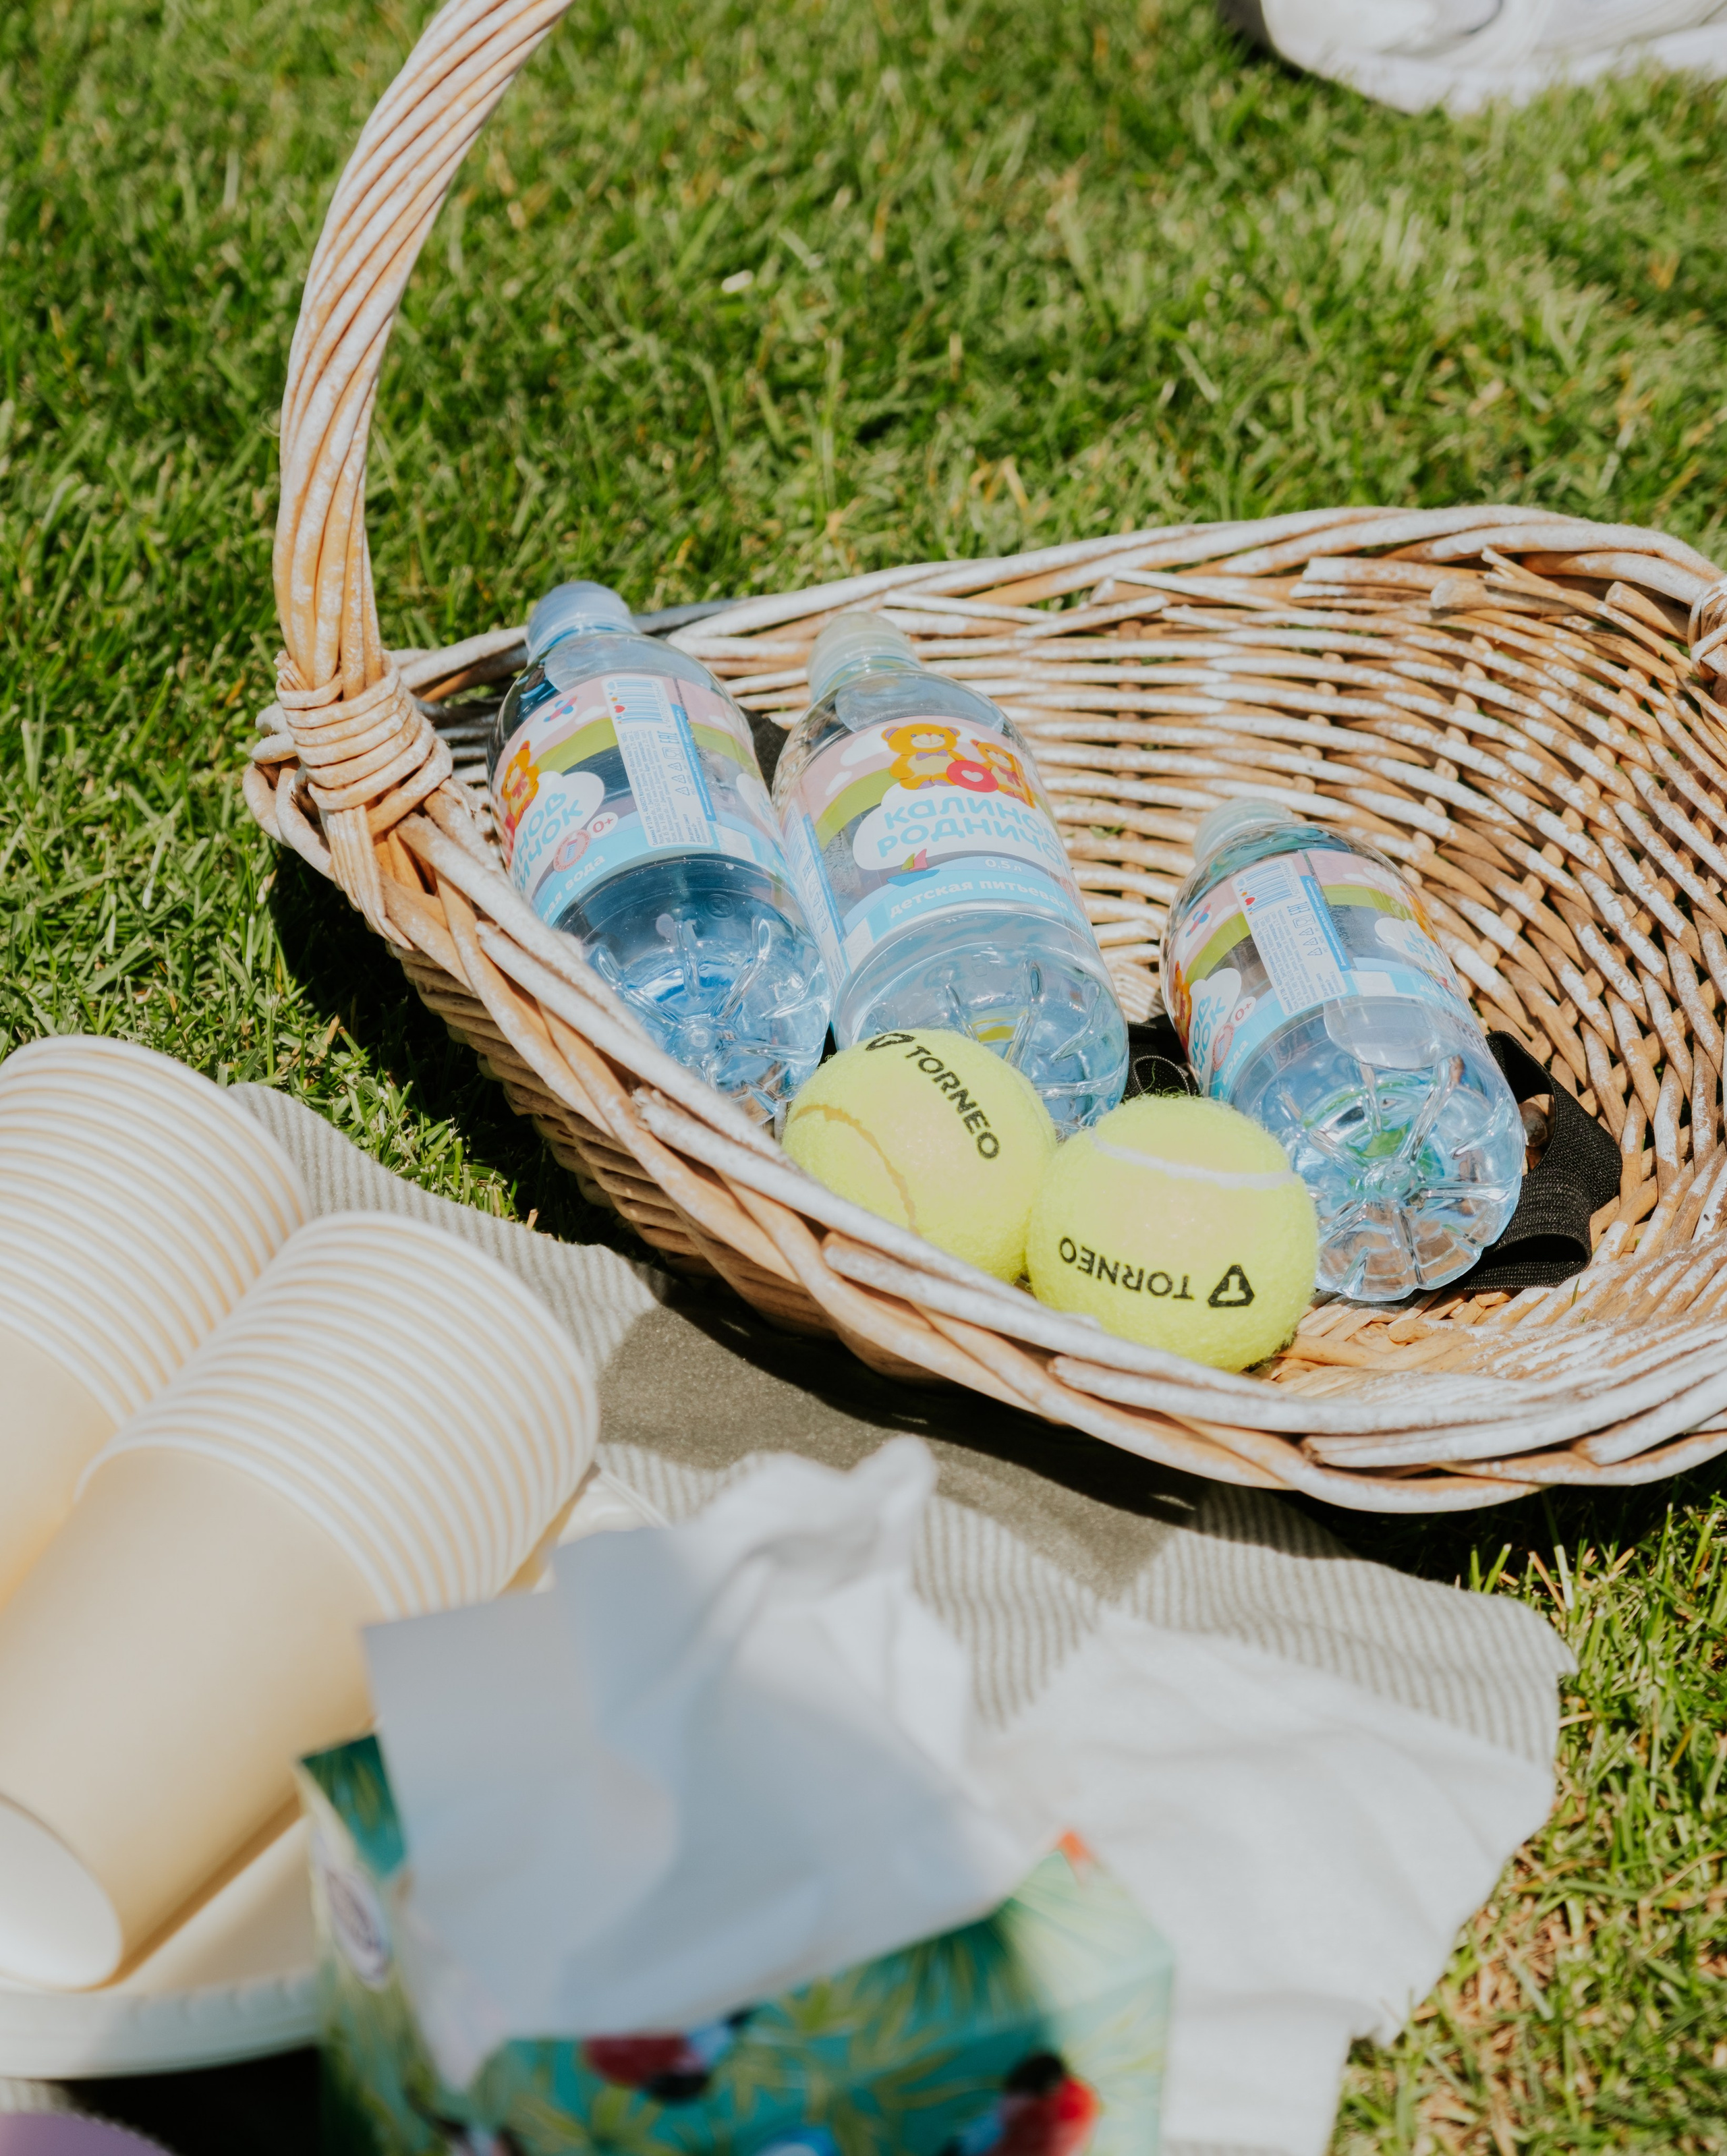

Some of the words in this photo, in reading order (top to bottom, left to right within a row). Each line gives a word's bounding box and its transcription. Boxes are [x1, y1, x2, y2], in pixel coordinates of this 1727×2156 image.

[565, 855, 606, 891] вода
[984, 858, 1011, 871] 0,5
[1012, 864, 1023, 872] л
[889, 880, 974, 919] детская
[979, 879, 1069, 912] питьевая
[1222, 1040, 1249, 1087] вода
[905, 1044, 1001, 1160] TORNEO
[1058, 1237, 1195, 1301] TORNEO
